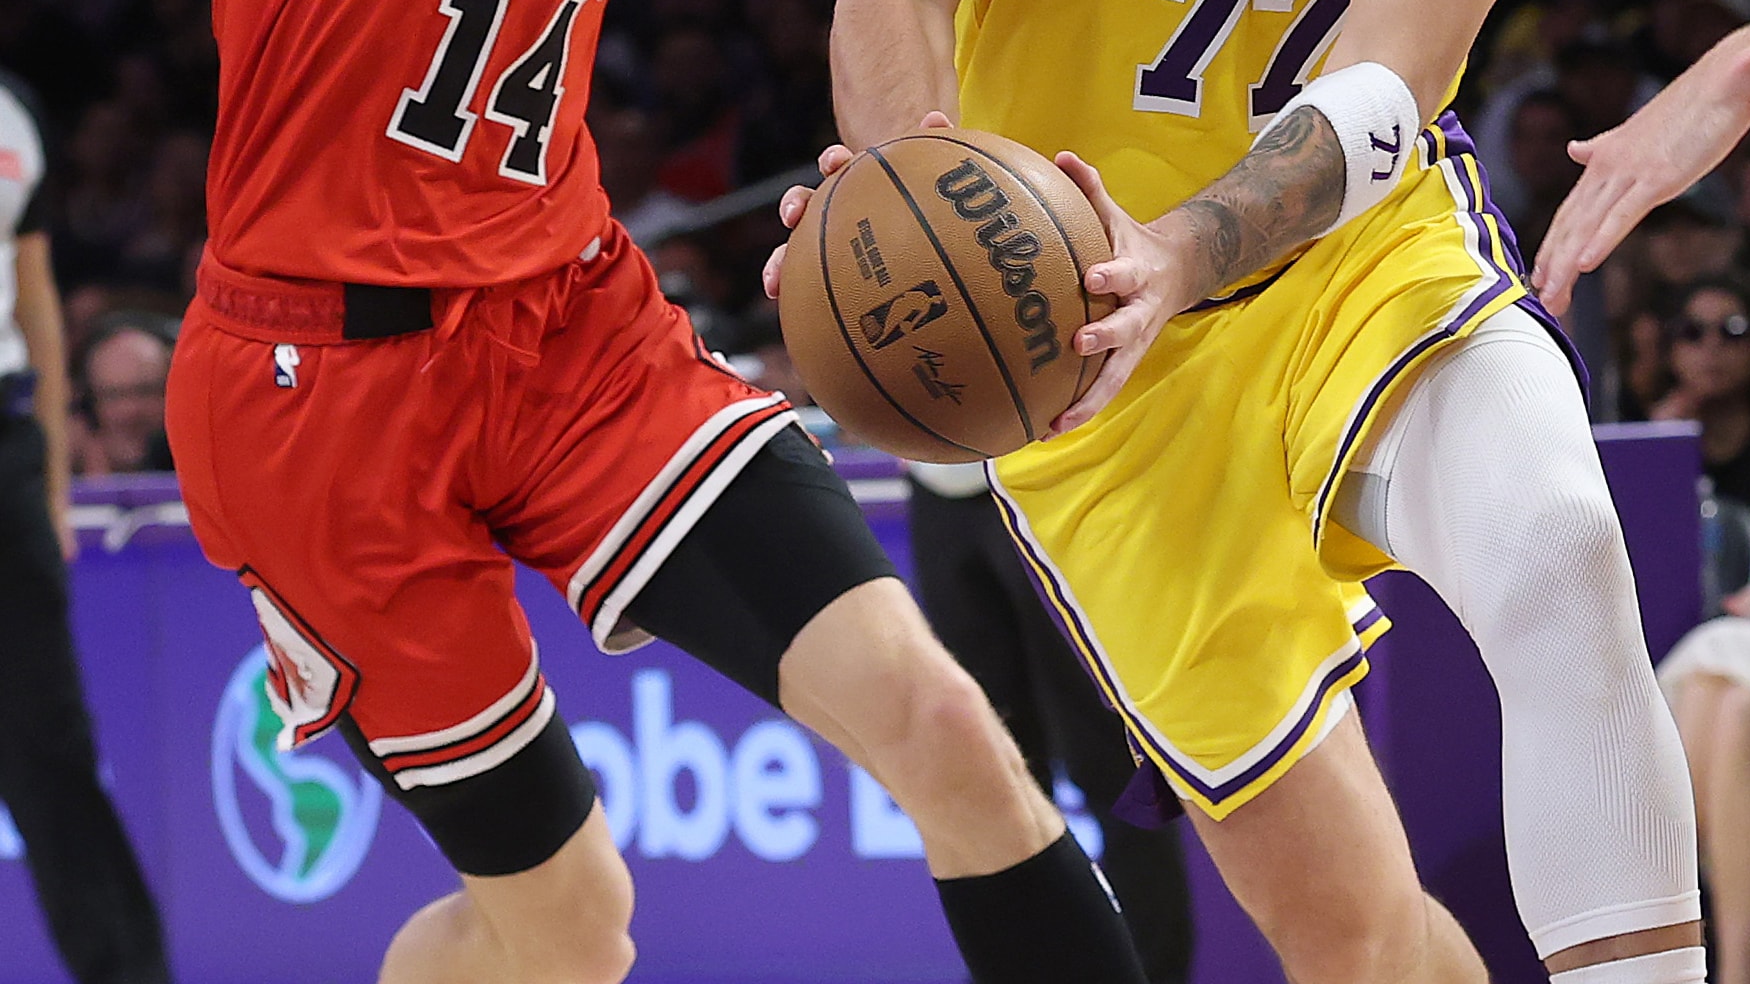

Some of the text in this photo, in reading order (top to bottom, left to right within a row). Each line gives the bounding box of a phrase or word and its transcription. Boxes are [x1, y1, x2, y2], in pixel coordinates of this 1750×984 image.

[1367, 122, 1401, 185] 77
[934, 157, 1063, 377] Wilson
[569, 669, 824, 862] obe
